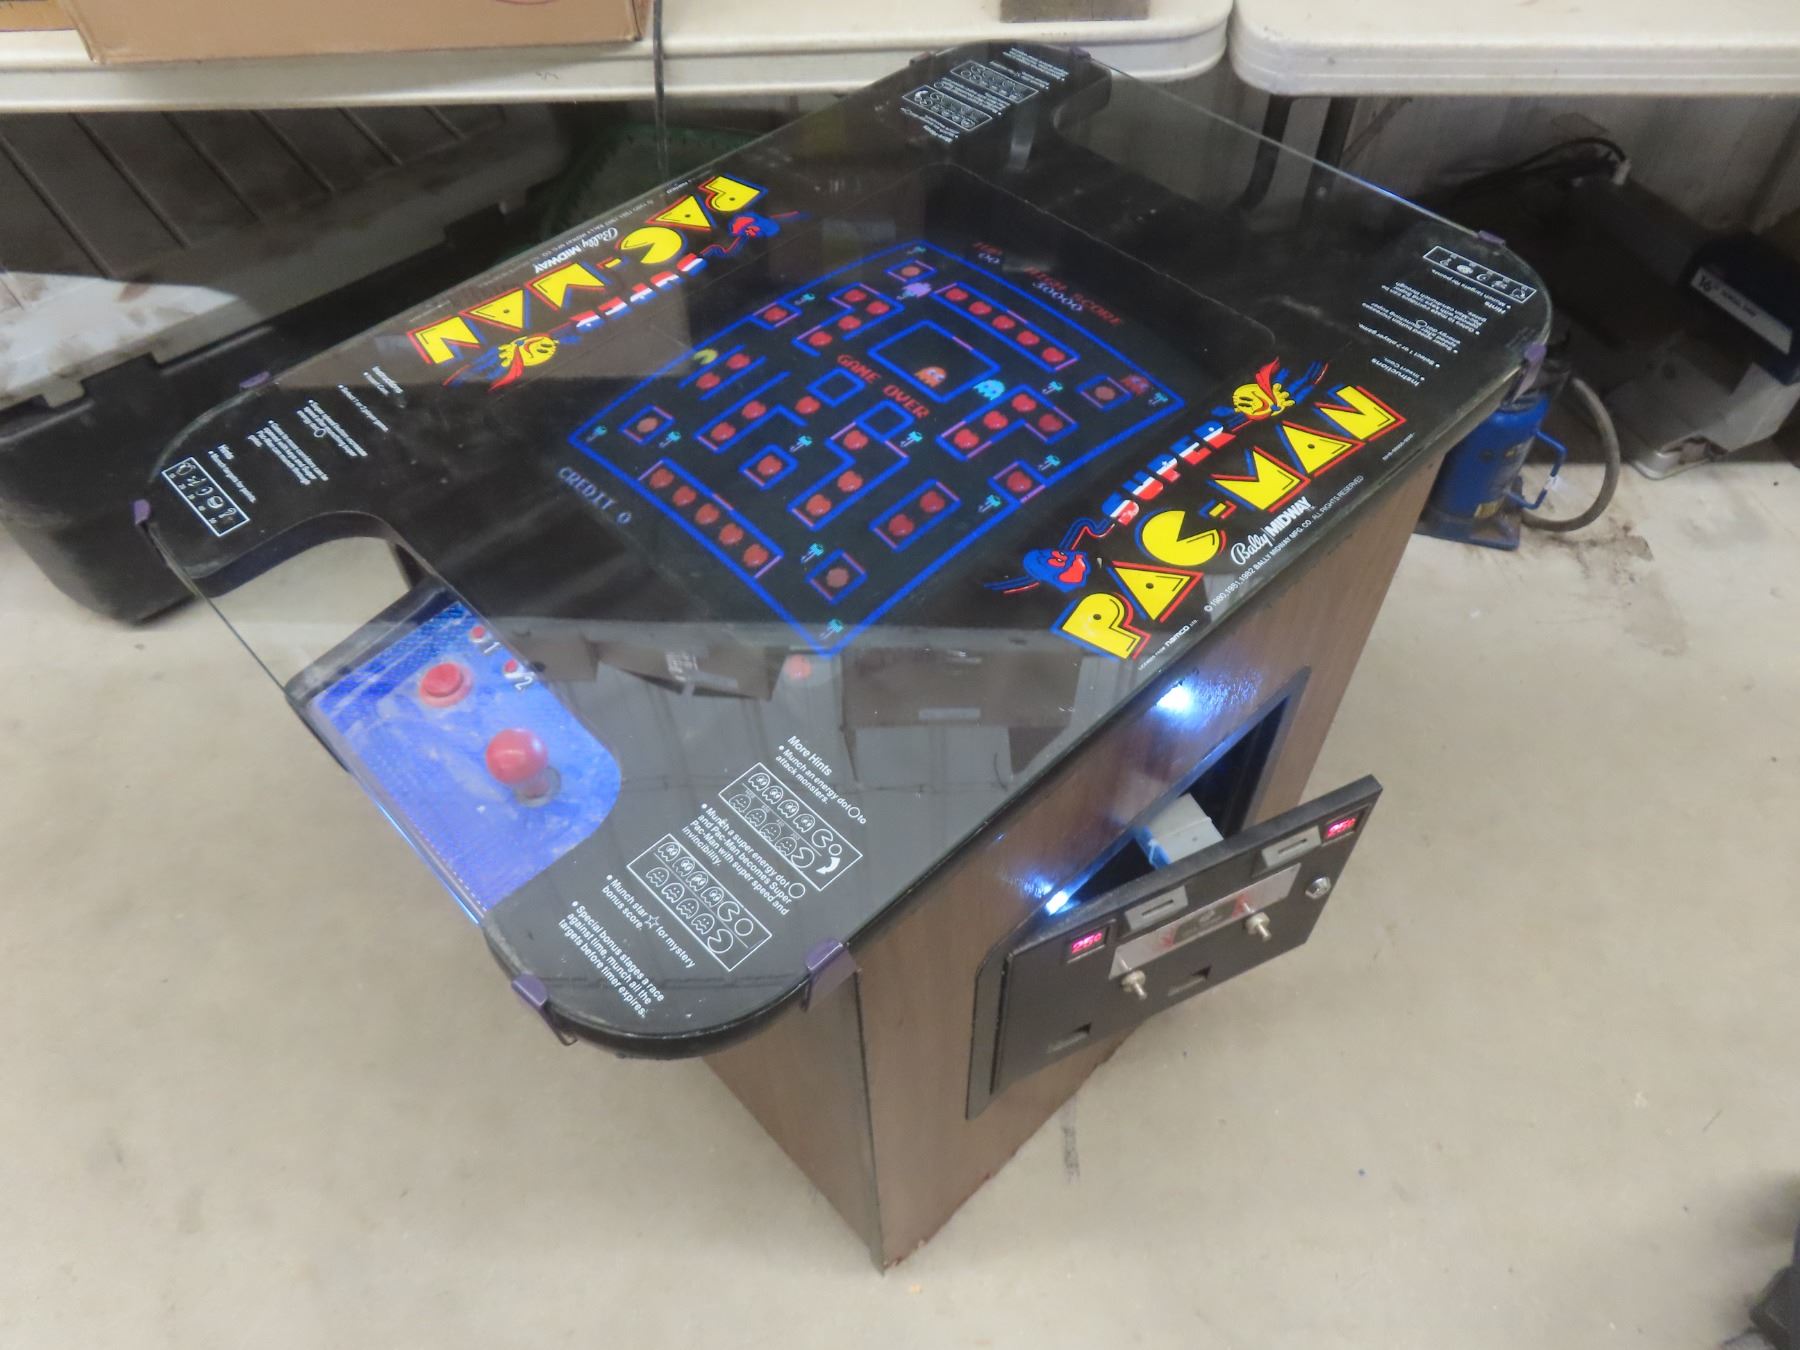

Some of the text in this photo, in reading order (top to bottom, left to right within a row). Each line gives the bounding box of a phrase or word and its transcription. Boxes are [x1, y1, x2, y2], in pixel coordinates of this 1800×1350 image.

[406, 174, 769, 365] PAC-MAN
[533, 243, 582, 274] MIDWAY
[1484, 301, 1506, 314] Hints
[837, 354, 930, 418] GAME OVER
[1371, 358, 1423, 387] Instructions
[559, 466, 632, 524] CREDIT 0
[1101, 420, 1237, 526] SUPER
[1048, 382, 1406, 661] PAC-MAN
[1231, 496, 1311, 566] Bally MIDWAY
[1252, 554, 1272, 570] BALLY
[483, 641, 500, 654] 1
[1164, 625, 1190, 647] namco
[775, 756, 829, 804] attack monsters.
[782, 749, 867, 824] Munch an energy dot to
[787, 735, 832, 776] More Hints
[690, 820, 790, 916] Pac-Man with super speed and
[698, 815, 714, 829] and
[710, 826, 740, 856] Pac-Man
[738, 852, 771, 885] becomes
[769, 882, 794, 904] Super
[706, 807, 730, 832] Munch
[730, 834, 754, 854] super
[752, 852, 778, 877] energy
[775, 874, 790, 888] dot
[602, 885, 643, 930] bonus score.
[610, 878, 695, 968] Munch star for mystery
[558, 919, 646, 1017] targets before timer expires.
[567, 913, 651, 1005] against time, munch all the
[576, 905, 604, 933] Special
[598, 930, 622, 956] bonus
[619, 954, 644, 980] stages
[646, 983, 664, 1002] race
